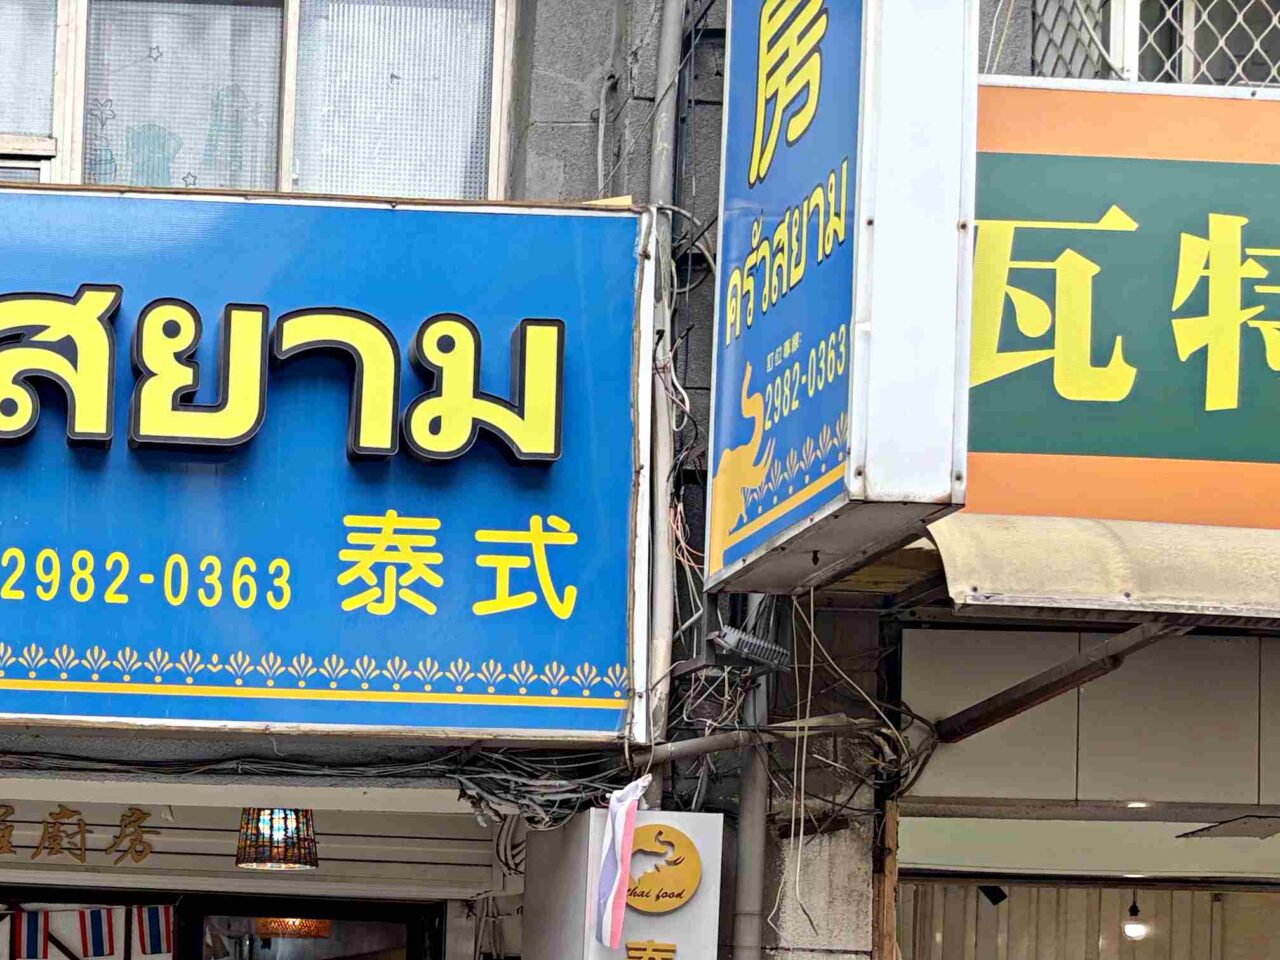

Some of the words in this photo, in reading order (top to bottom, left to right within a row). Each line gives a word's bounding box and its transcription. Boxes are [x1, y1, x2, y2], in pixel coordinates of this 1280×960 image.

[724, 156, 849, 347] ครัวสยาม
[764, 323, 846, 431] 2982-0363
[0, 546, 292, 611] 2982-0363
[337, 509, 579, 620] 泰式
[654, 887, 686, 903] food
